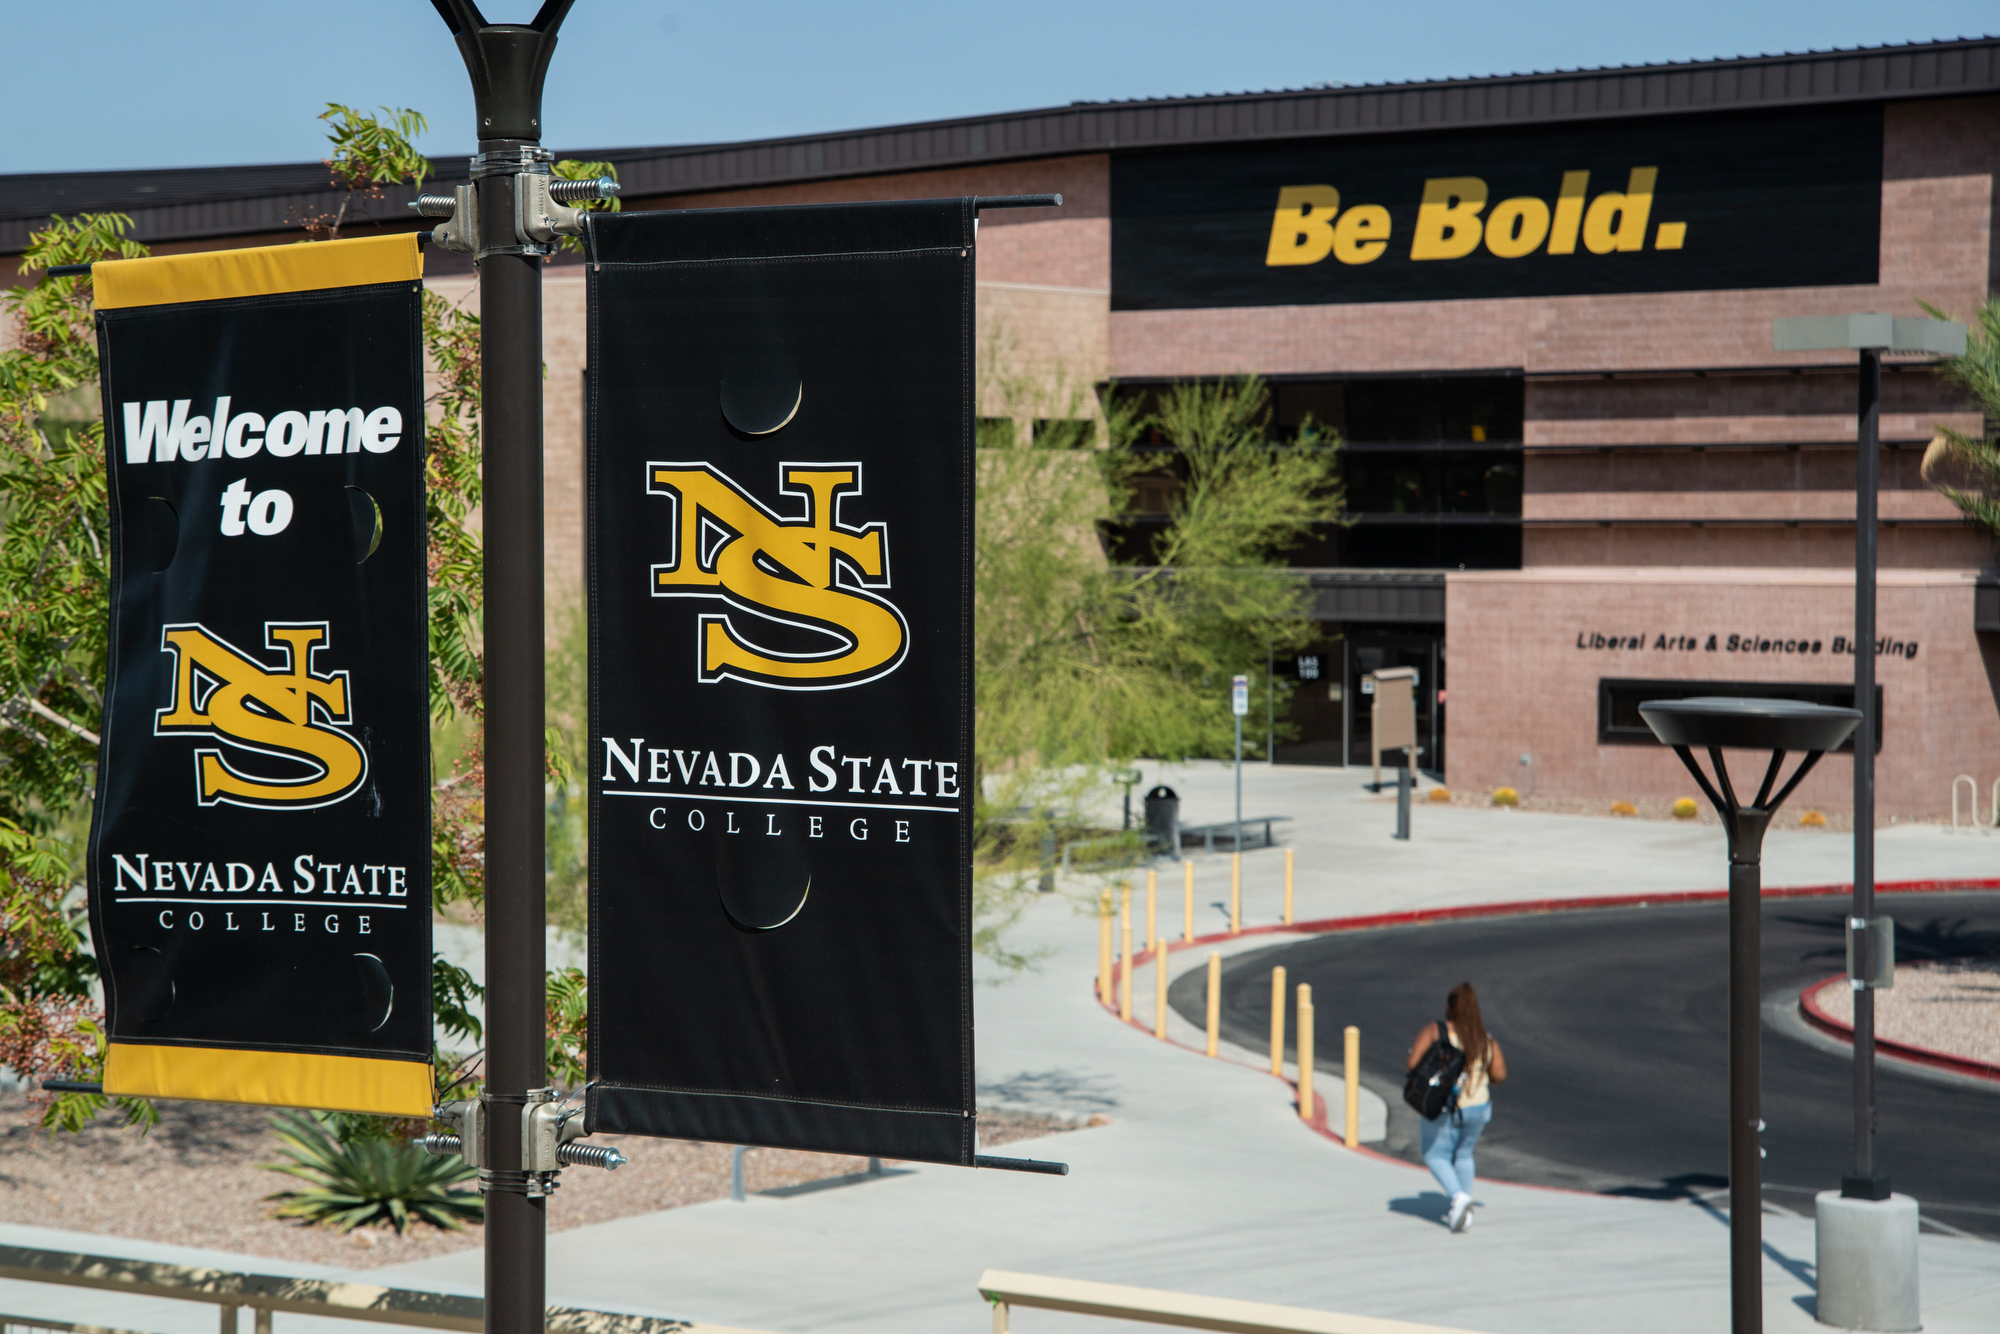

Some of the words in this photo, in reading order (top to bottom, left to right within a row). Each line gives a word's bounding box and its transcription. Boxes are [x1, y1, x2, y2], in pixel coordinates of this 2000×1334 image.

[1266, 184, 1391, 266] Be
[1410, 166, 1687, 260] Bold.
[123, 396, 402, 464] Welcome
[221, 478, 293, 536] to
[1577, 633, 1645, 650] Liberal
[1654, 634, 1697, 651] Arts
[1705, 634, 1717, 652] &
[1726, 634, 1822, 654] Sciences
[1832, 637, 1918, 660] Buding
[602, 737, 794, 789] NEVADA
[809, 746, 960, 797] STATE
[650, 807, 910, 842] COLLEGE
[112, 854, 283, 892] NEVADA
[294, 855, 407, 896] STATE
[160, 911, 371, 933] COLLEGE
